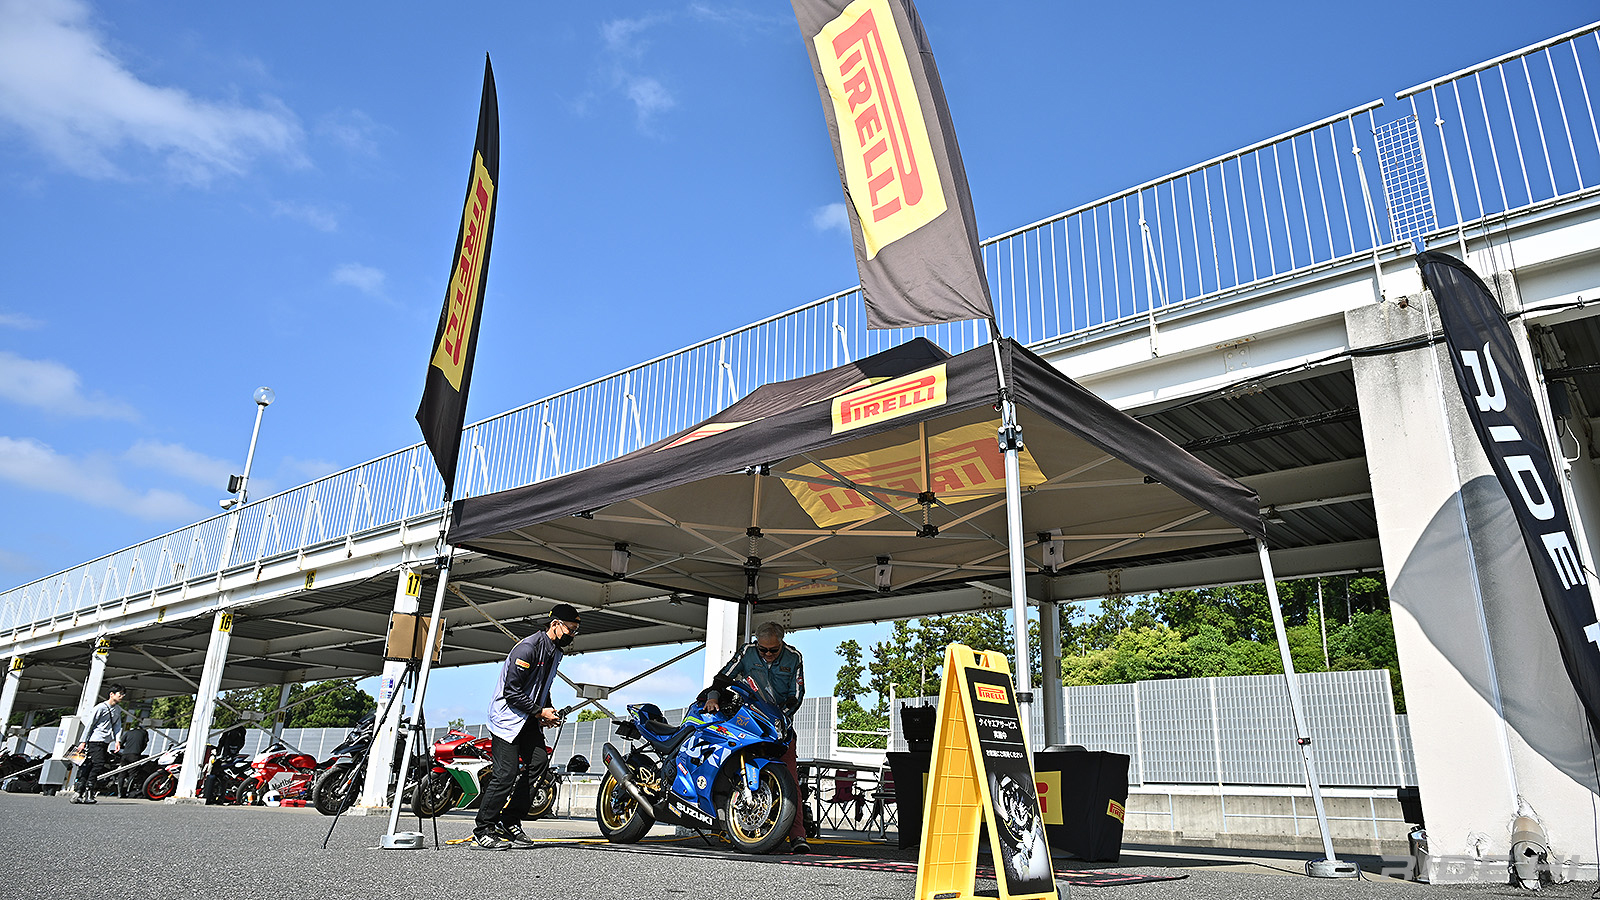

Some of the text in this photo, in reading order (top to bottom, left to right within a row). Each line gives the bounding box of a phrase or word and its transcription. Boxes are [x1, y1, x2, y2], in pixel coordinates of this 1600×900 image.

[832, 8, 924, 223] PIRELLI
[445, 176, 489, 367] PIRELLI
[840, 375, 936, 425] PIRELLI
[1460, 342, 1588, 591] RIDE
[408, 574, 420, 594] 17
[220, 614, 232, 630] 16
[978, 686, 1006, 701] PIRELLI
[676, 801, 713, 826] SUZUKI
